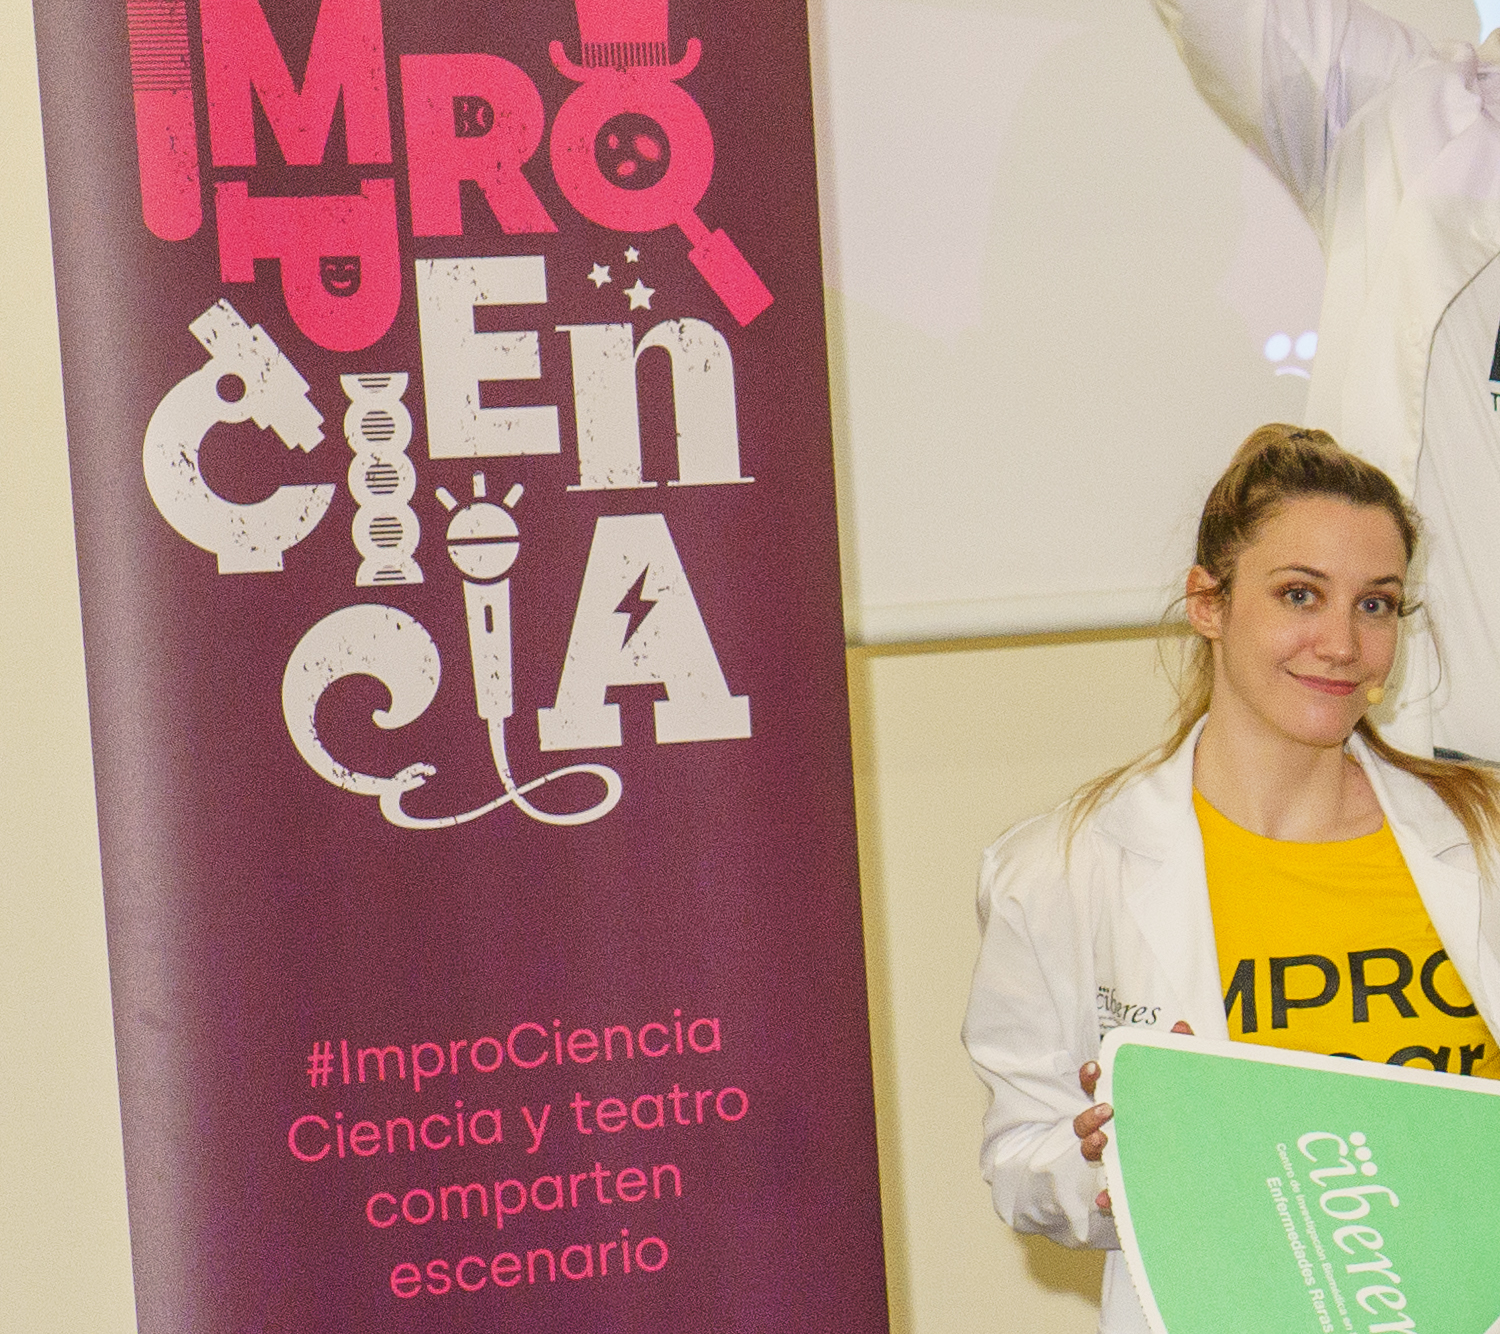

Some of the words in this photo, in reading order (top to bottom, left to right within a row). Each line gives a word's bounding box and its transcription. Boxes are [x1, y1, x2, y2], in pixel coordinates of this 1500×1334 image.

[307, 1009, 721, 1092] #ImproCiencia
[288, 1100, 502, 1162] Ciencia
[520, 1103, 551, 1154] y
[570, 1083, 748, 1136] teatro
[366, 1161, 682, 1228] comparten
[390, 1228, 669, 1298] escenario
[1266, 1177, 1315, 1286] Enfermedades
[1309, 1288, 1334, 1333] Raras
[1276, 1143, 1295, 1178] Centro
[1290, 1179, 1300, 1193] de
[1343, 1317, 1353, 1330] en
